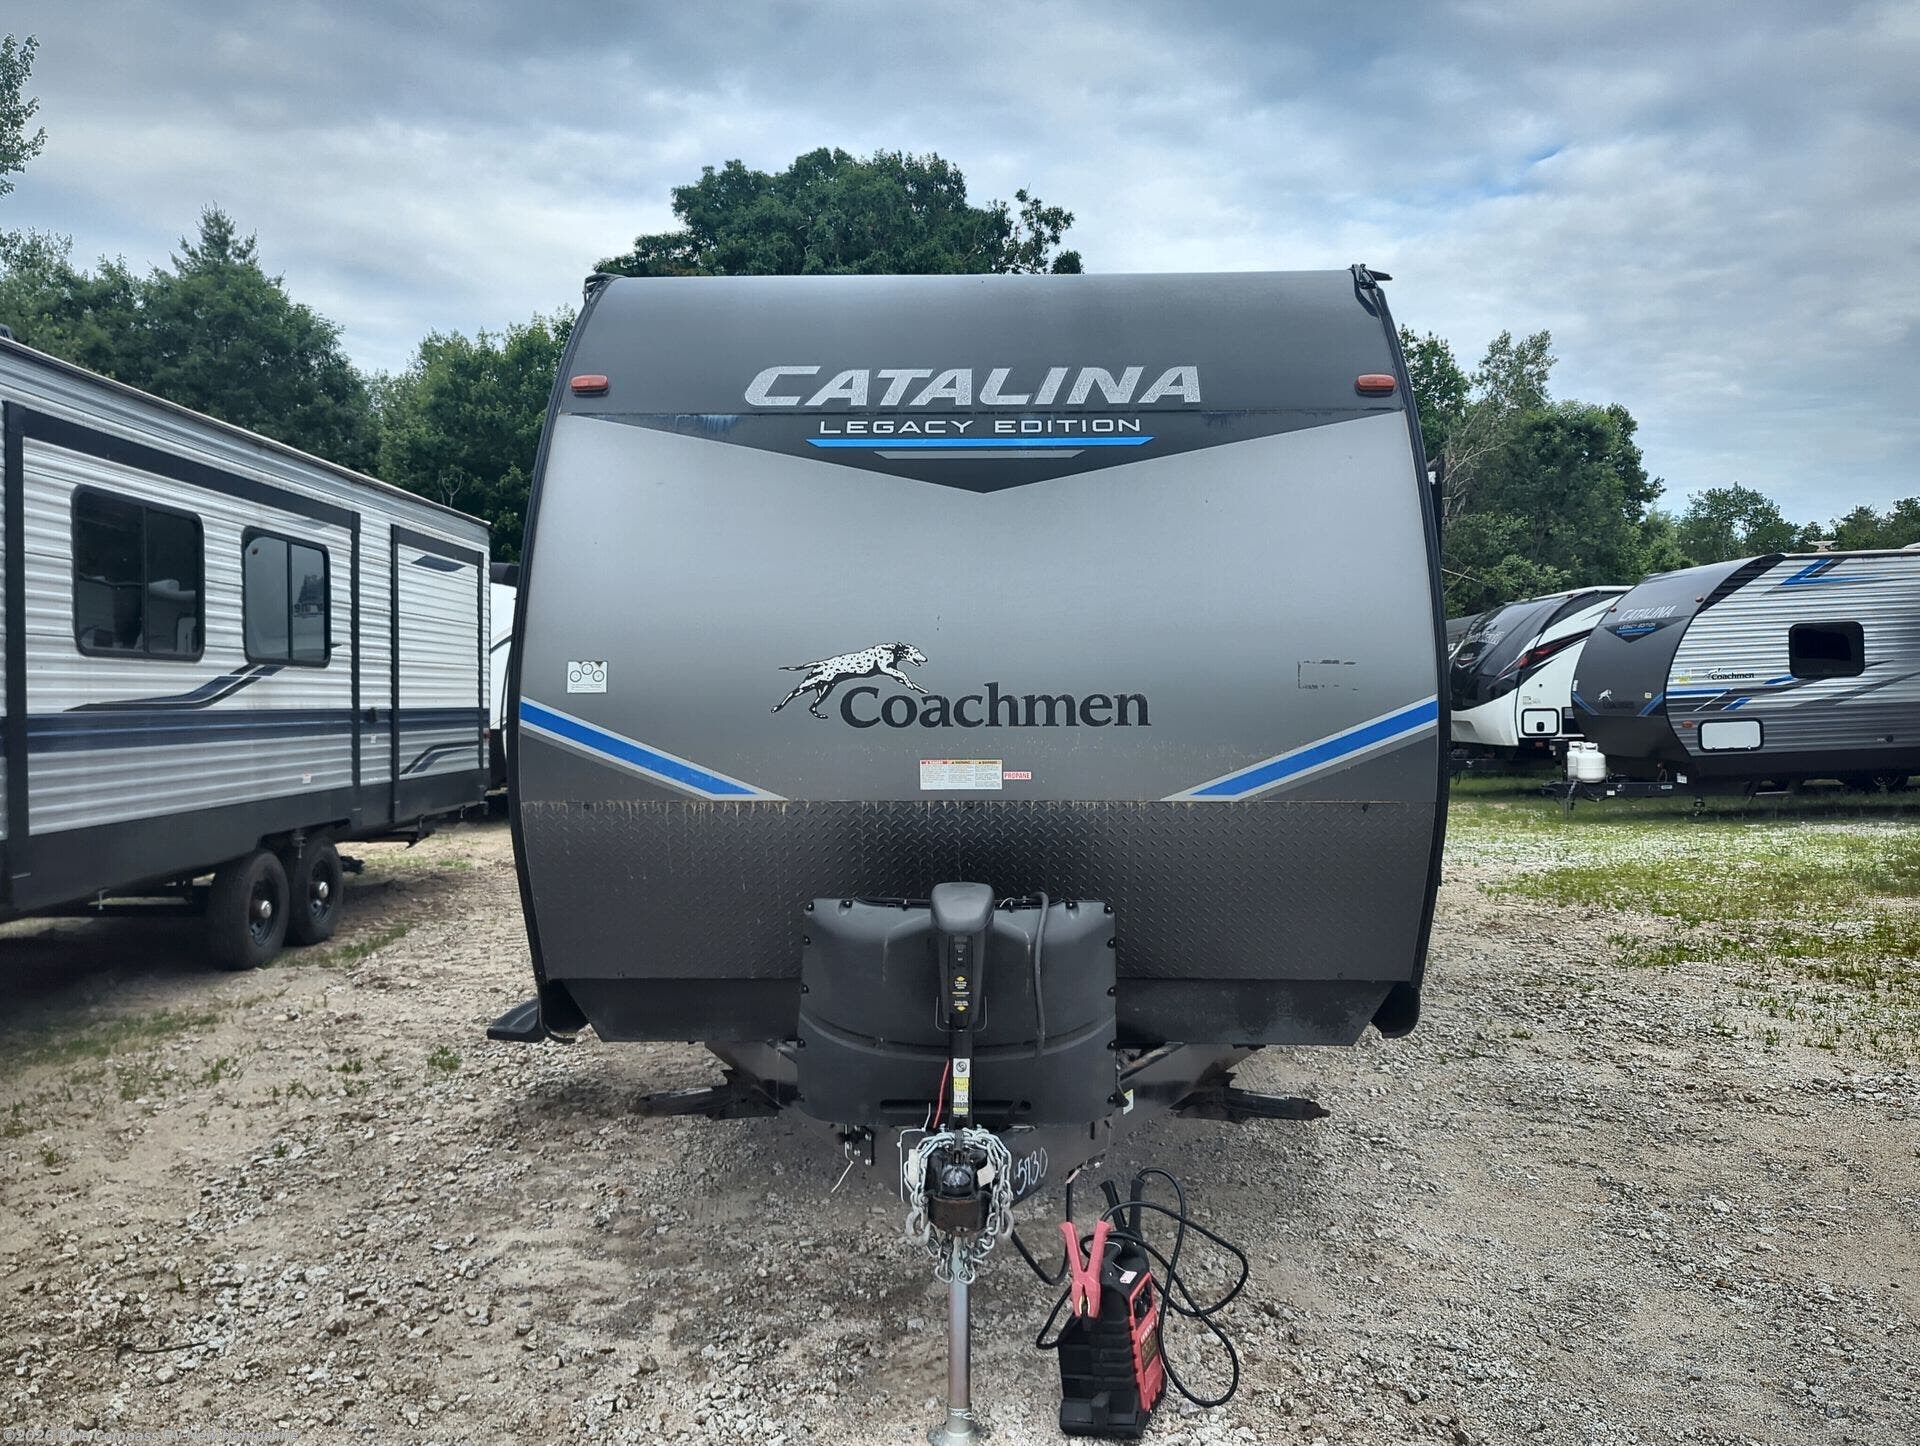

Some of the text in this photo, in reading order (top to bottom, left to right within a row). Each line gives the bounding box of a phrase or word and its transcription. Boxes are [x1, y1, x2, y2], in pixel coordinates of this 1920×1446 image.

[744, 365, 1202, 407] CATALINA
[819, 418, 1141, 435] LEGACY EDITION
[1711, 672, 1755, 680] Coachmen
[840, 681, 1152, 729] Coachmen
